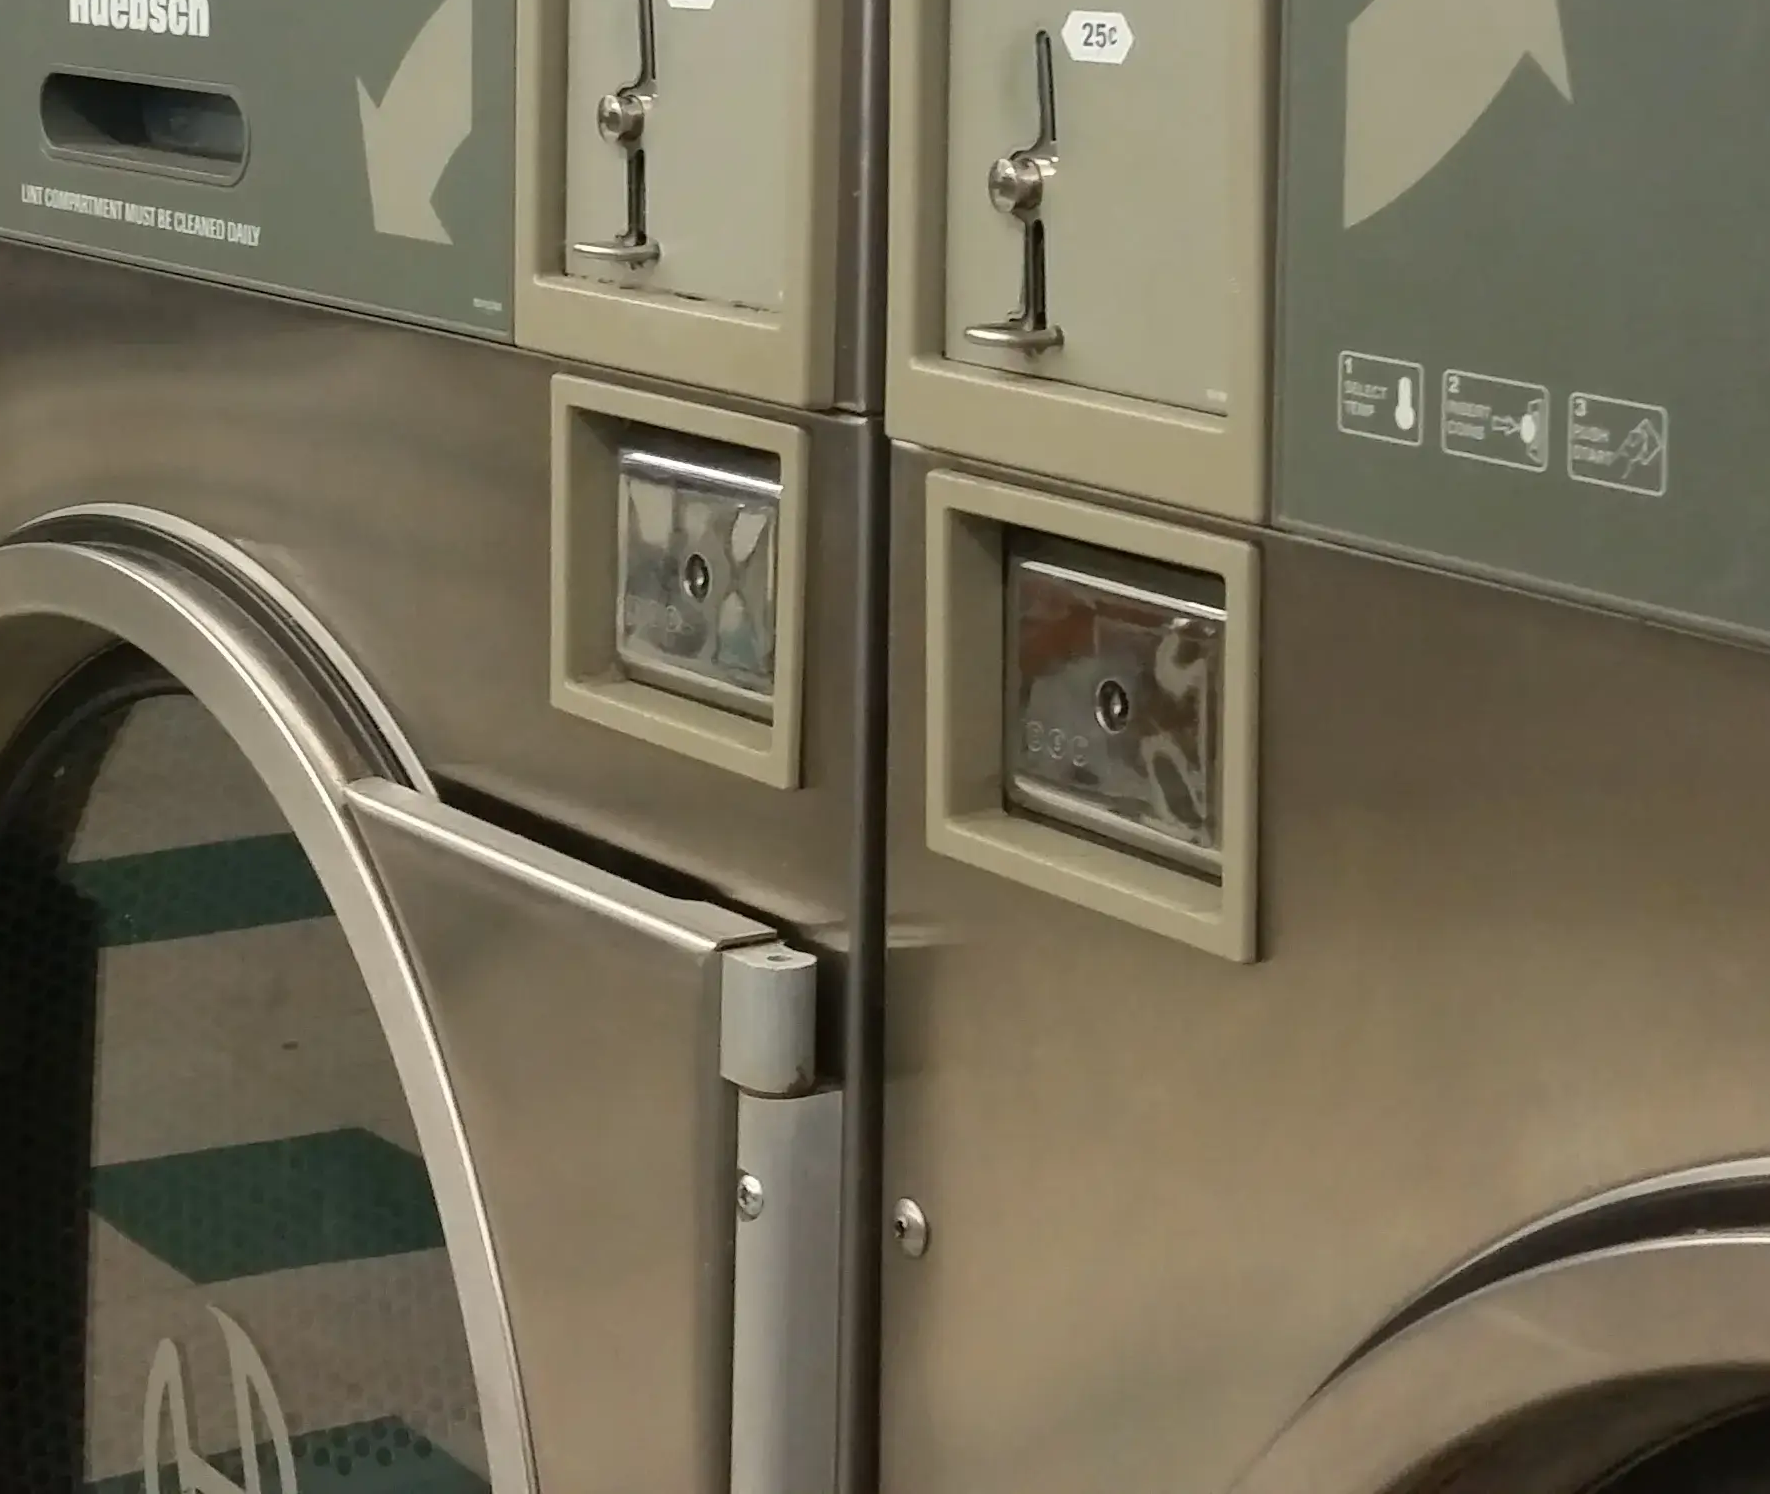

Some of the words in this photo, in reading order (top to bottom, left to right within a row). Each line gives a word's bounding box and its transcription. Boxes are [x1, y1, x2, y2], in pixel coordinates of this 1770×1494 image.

[125, 202, 156, 227] MUST
[157, 208, 173, 230] BE
[174, 212, 225, 240] CLEANED
[227, 221, 261, 247] DAILY
[1448, 376, 1460, 394] 2
